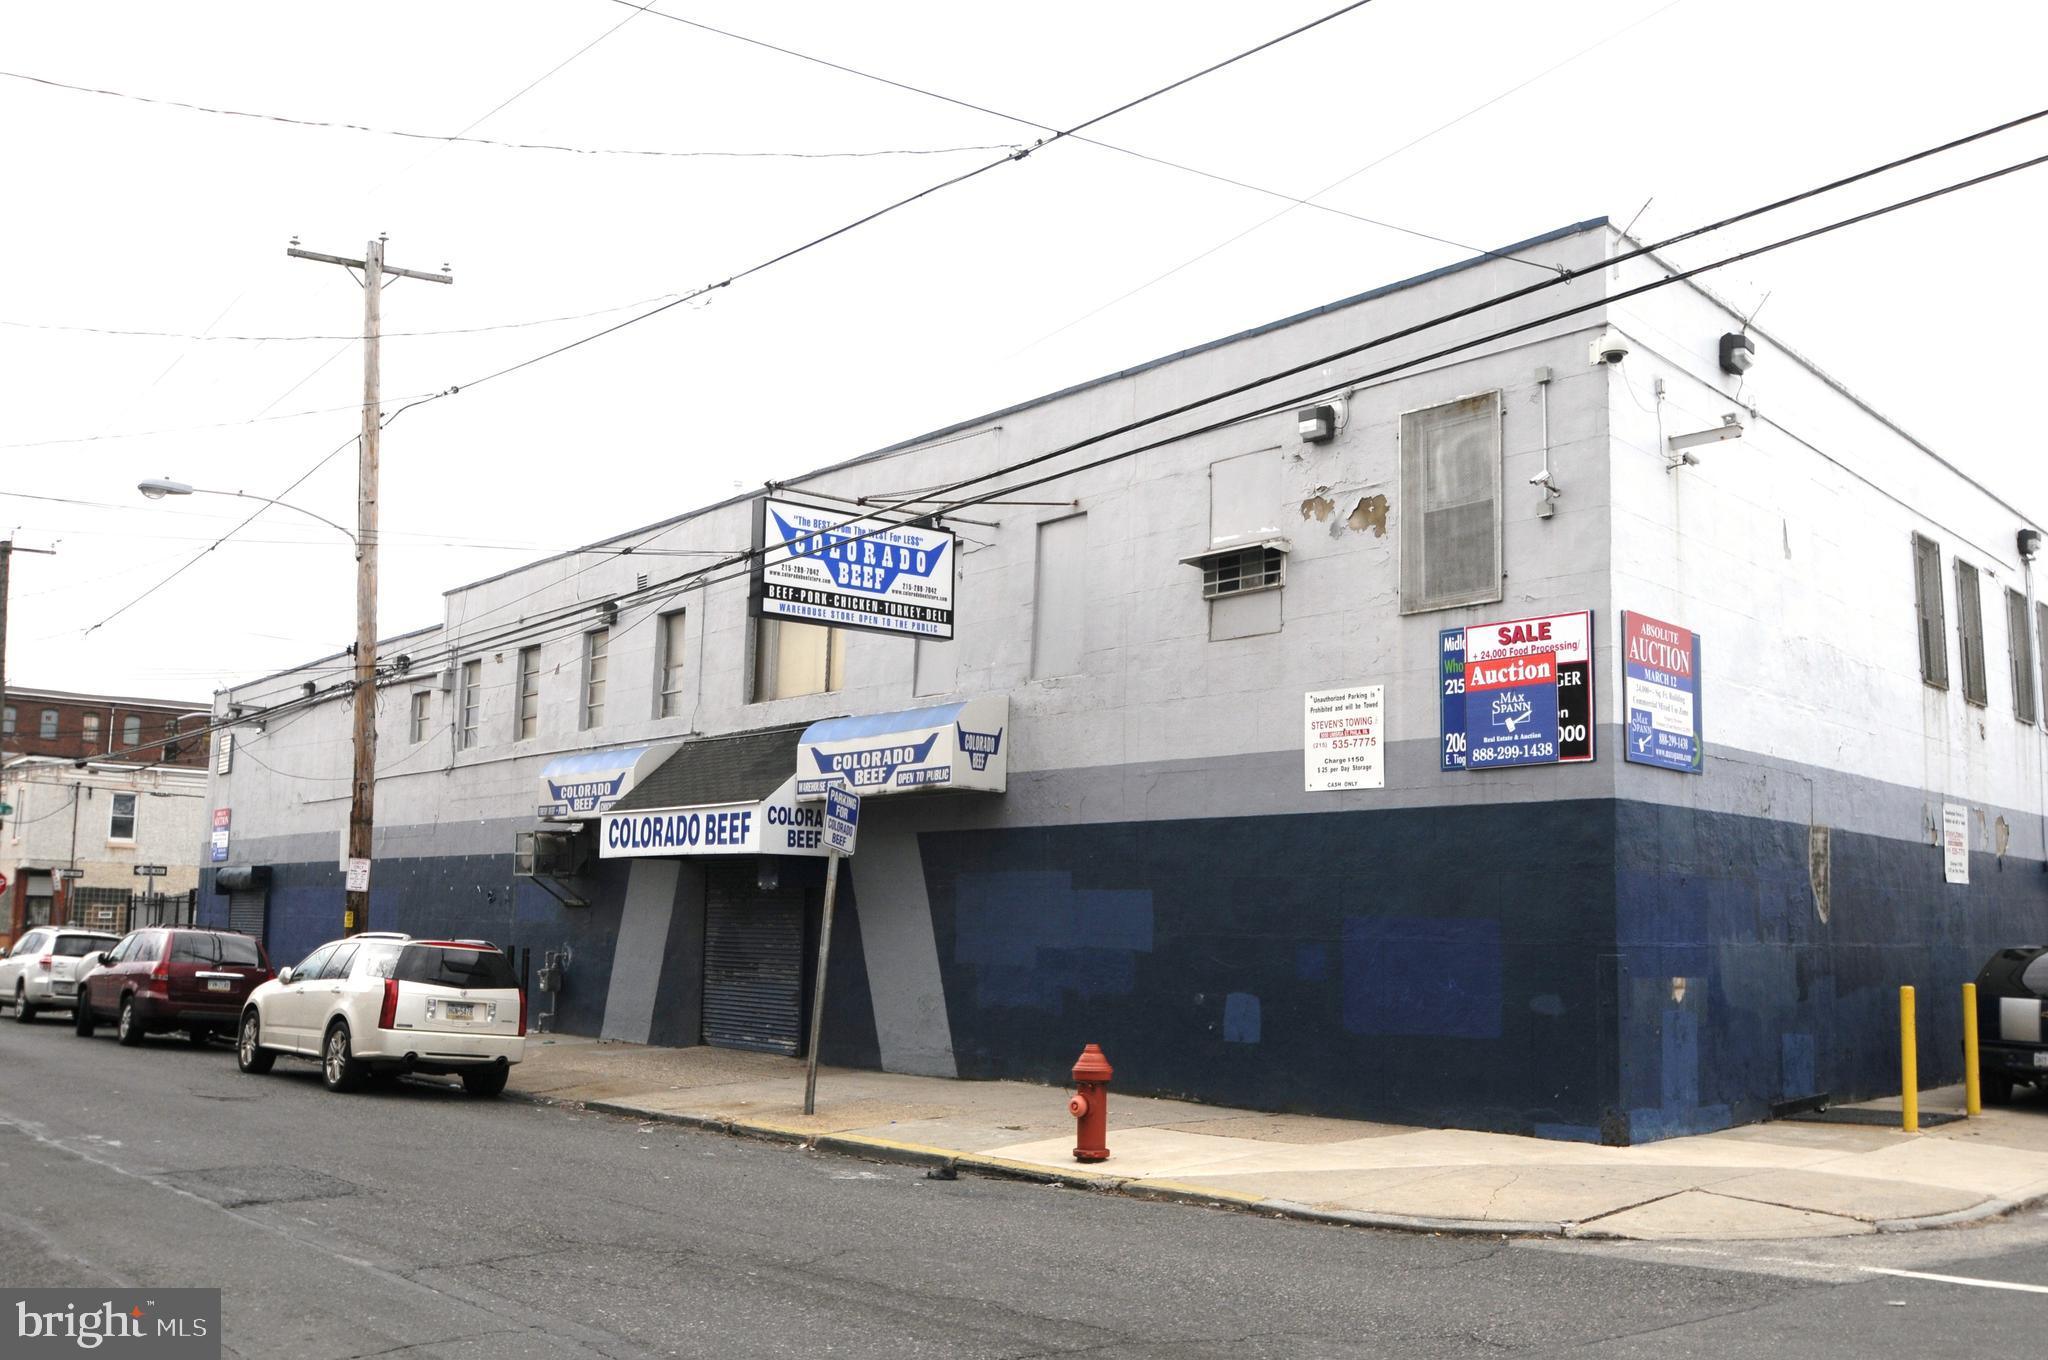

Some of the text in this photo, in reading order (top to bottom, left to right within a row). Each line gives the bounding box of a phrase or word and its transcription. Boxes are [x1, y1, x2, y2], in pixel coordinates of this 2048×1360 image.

[813, 519, 831, 530] BEST
[854, 525, 868, 537] The
[890, 532, 902, 543] For
[794, 530, 927, 574] COLORADO
[838, 562, 885, 590] BEEF
[779, 602, 938, 634] WAREHOUSE STORE OPEN TO THE PUBLIC
[1498, 622, 1552, 646] SALE
[1640, 623, 1679, 645] ABSOLUTE
[1480, 648, 1507, 660] 24,000
[1509, 646, 1528, 656] Food
[1629, 636, 1690, 674] AUCTION
[1470, 660, 1551, 686] Auction
[1644, 668, 1677, 688] MARCH 12
[1445, 678, 1465, 695] 215
[1313, 694, 1346, 704] Unauthorized
[1348, 692, 1368, 701] Parking
[1310, 706, 1333, 714] Prohibited
[1335, 704, 1343, 712] and
[1312, 716, 1373, 730] STEVEN'S TOWING
[964, 733, 996, 753] COLORADO
[1332, 737, 1376, 749] 535-7775
[1446, 732, 1466, 753] 206
[1520, 732, 1542, 740] Auction
[832, 748, 915, 771] COLORADO
[972, 752, 985, 769] BEEF
[1324, 757, 1346, 765] Charge
[1472, 742, 1553, 762] 888-299-1438
[854, 767, 888, 786] BEEF
[898, 768, 950, 784] OPEN TO PUBLIC
[1352, 764, 1372, 772] Storage
[560, 782, 611, 799] COLORADO
[830, 790, 857, 810] PARKING
[574, 798, 594, 811] BEEF
[836, 804, 848, 820] FOR
[609, 811, 752, 849] COLORADO BEEF
[828, 818, 853, 838] COLORADO
[788, 830, 822, 848] BEEF
[832, 832, 847, 846] BEEF
